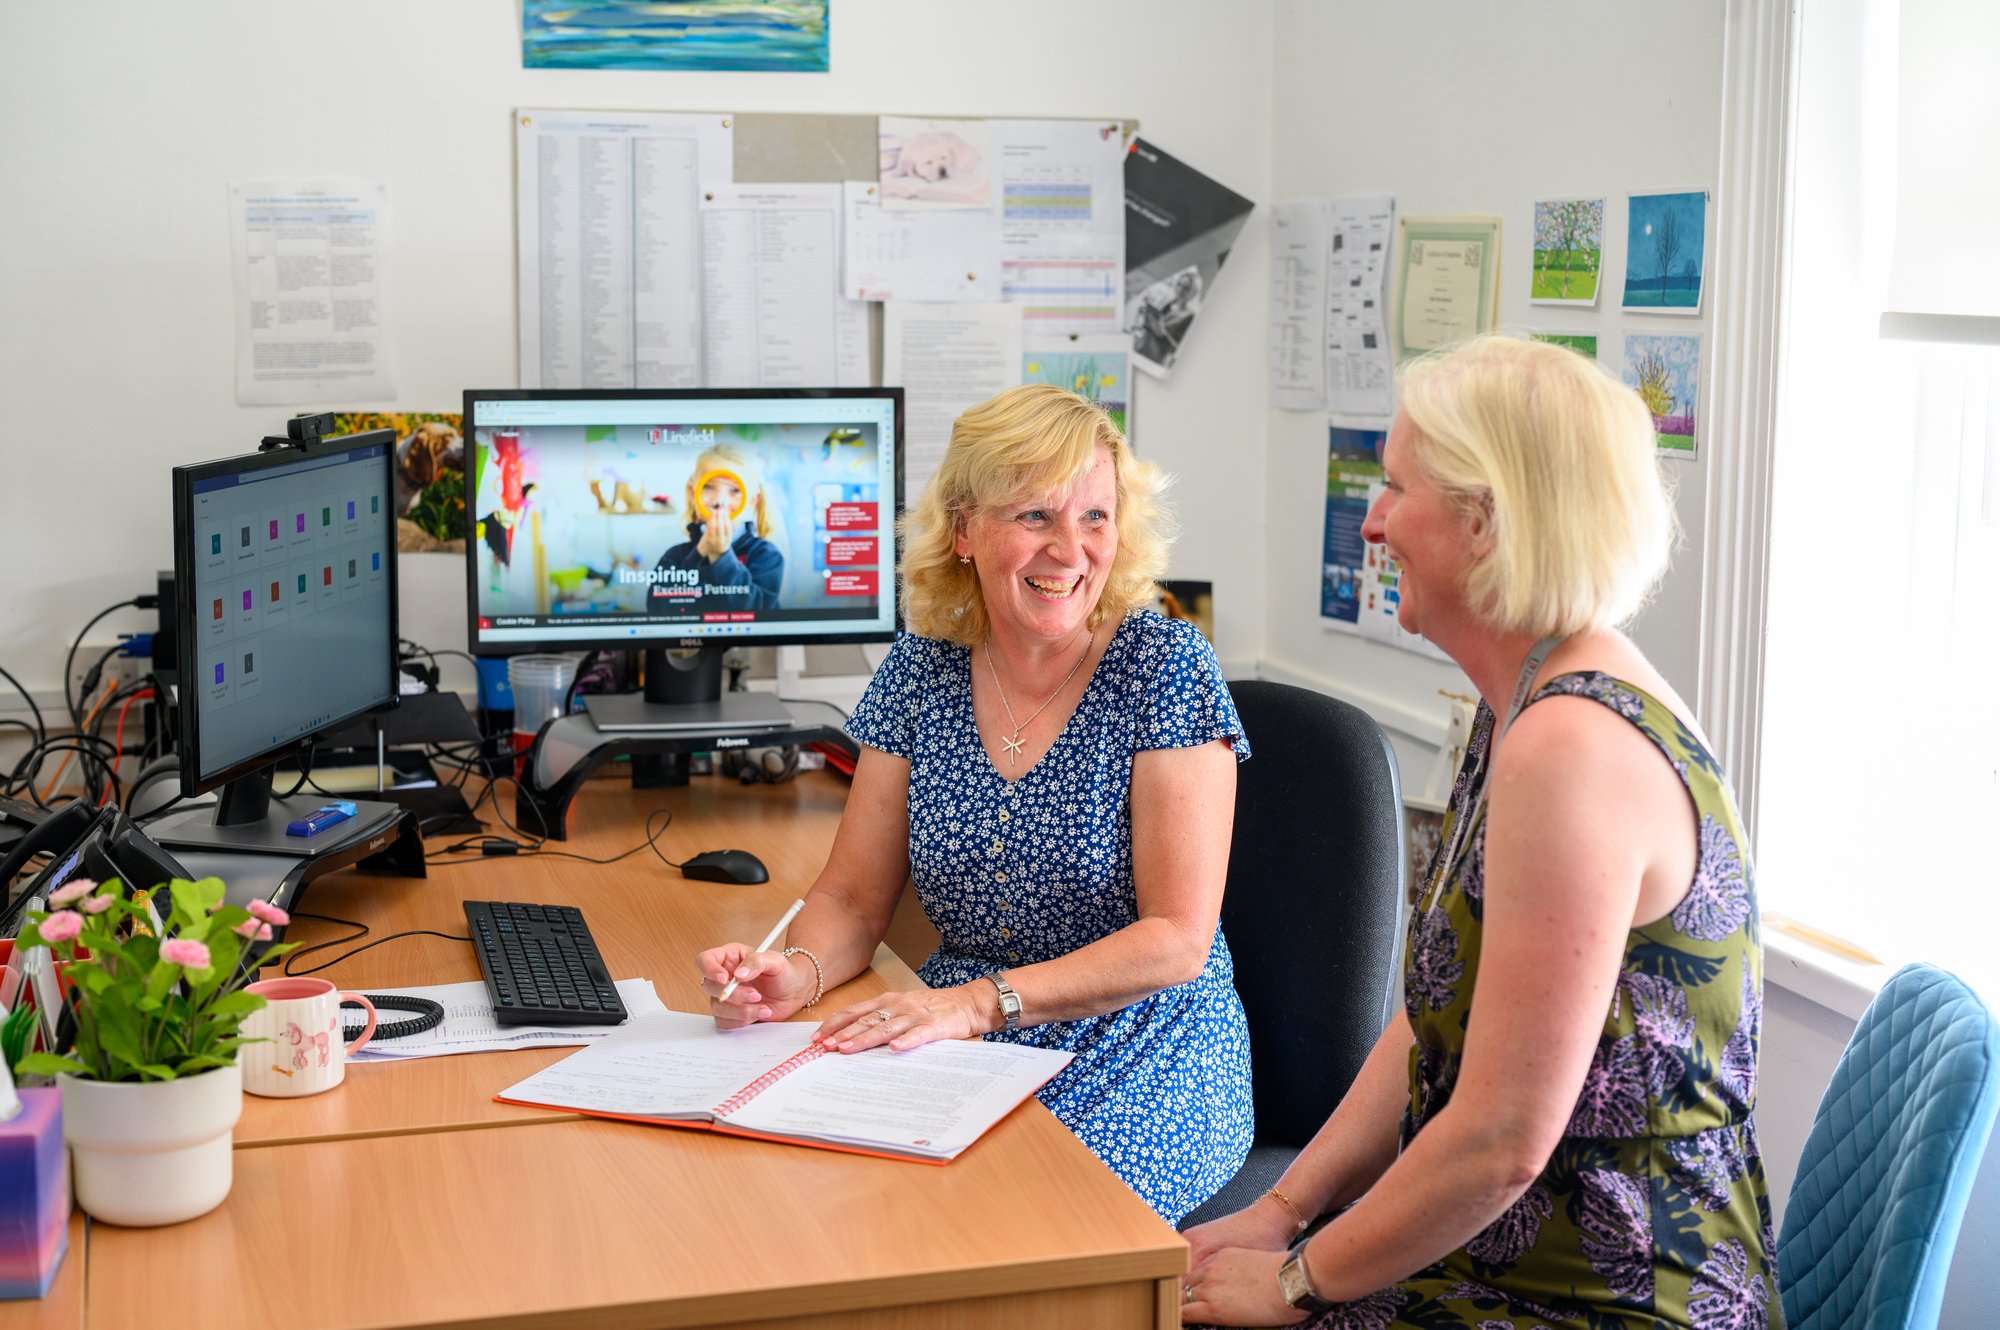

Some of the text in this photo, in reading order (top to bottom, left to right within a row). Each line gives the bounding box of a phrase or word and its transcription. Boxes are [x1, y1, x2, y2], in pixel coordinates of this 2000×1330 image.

[663, 428, 715, 446] Lingfield
[620, 565, 699, 586] Inspiring
[653, 584, 750, 598] Exciting Futures
[680, 638, 703, 647] DELL
